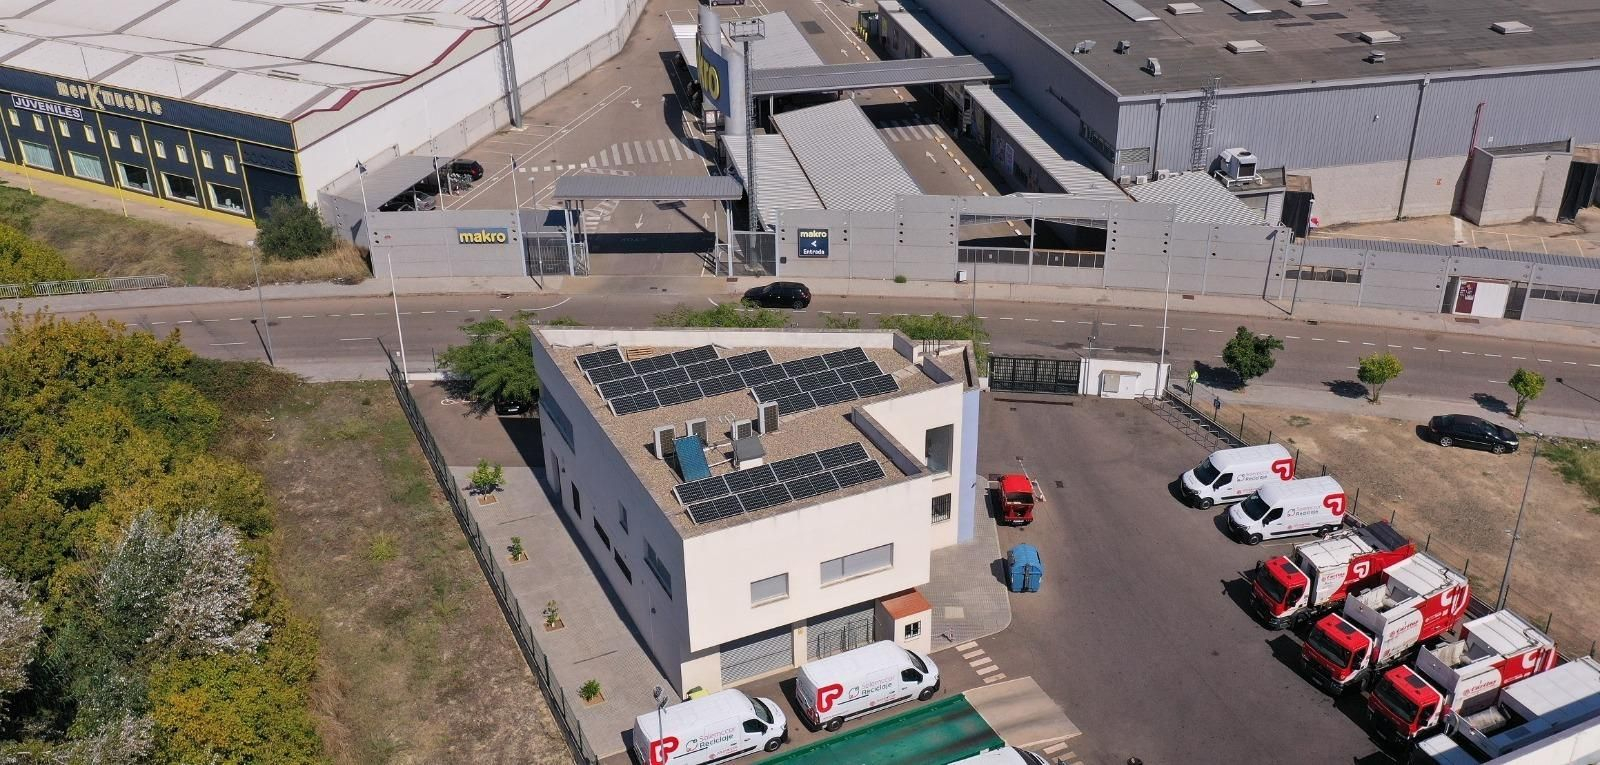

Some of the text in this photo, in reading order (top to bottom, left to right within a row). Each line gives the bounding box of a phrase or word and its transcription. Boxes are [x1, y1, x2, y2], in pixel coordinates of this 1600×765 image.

[15, 97, 81, 118] JUVENILES
[459, 229, 506, 243] makro
[800, 229, 828, 238] makro
[861, 682, 892, 696] Reciclaje
[699, 733, 734, 749] Reciclaje
